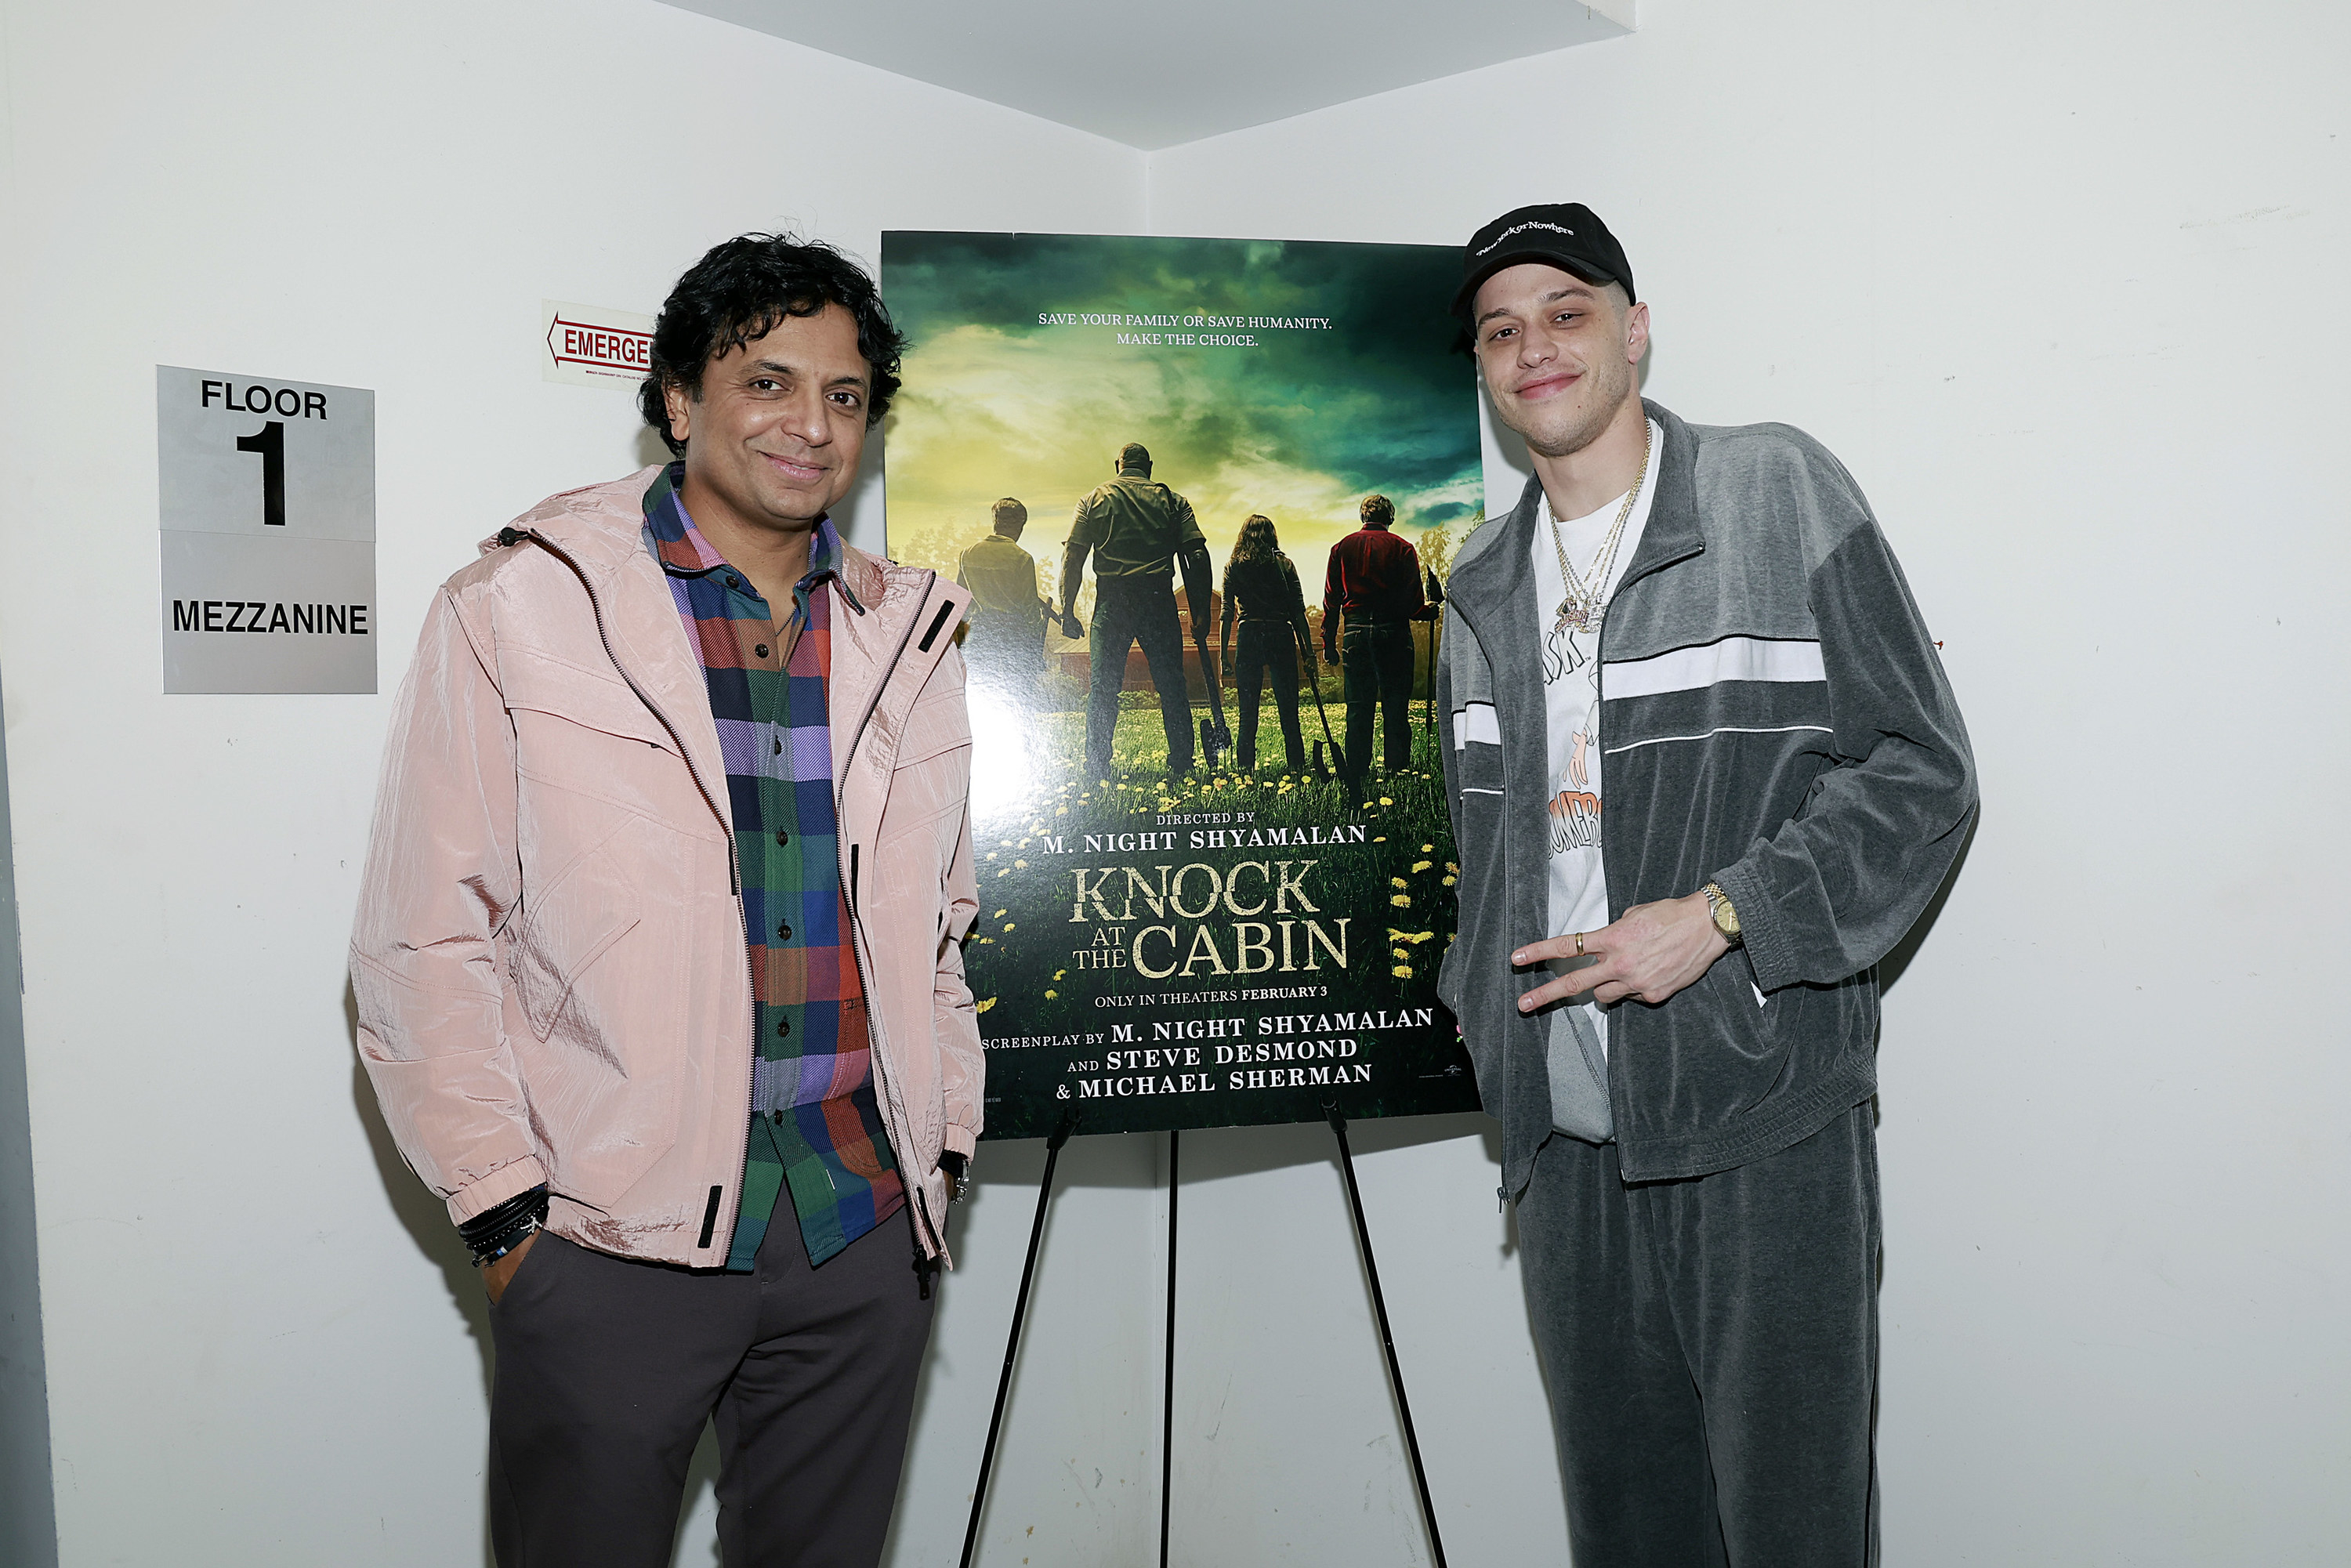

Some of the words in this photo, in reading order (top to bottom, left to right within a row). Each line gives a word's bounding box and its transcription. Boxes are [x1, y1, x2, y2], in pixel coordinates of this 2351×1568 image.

[1476, 241, 1498, 256] New
[1497, 226, 1516, 243] York
[1515, 223, 1528, 234] or
[1528, 221, 1574, 235] Nowhere
[1039, 313, 1076, 324] SAVE
[1081, 314, 1121, 325] YOUR
[1126, 315, 1179, 326] FAMILY
[1184, 316, 1204, 326] OR
[1208, 316, 1244, 327] SAVE
[1248, 317, 1331, 328] HUMANITY.
[566, 330, 654, 364] EMERGE
[1117, 334, 1161, 344] MAKE
[1165, 334, 1195, 345] THE
[1199, 335, 1258, 346] CHOICE.
[202, 380, 327, 419] FLOOR
[237, 421, 285, 526] 1
[173, 600, 368, 634] MEZZANINE
[1157, 813, 1231, 825] DIRECTED
[1236, 812, 1255, 824] BY
[1042, 836, 1073, 854] M.
[1083, 831, 1176, 853] NIGHT
[1190, 825, 1366, 849] SHYAMALAN
[1069, 859, 1320, 925] KNOCK
[1073, 949, 1126, 969] THE
[1132, 918, 1351, 979] CABIN
[1092, 927, 1125, 946] AT
[1096, 996, 1134, 1007] ONLY
[1139, 994, 1154, 1005] IN
[1160, 990, 1237, 1004] THEATERS
[1242, 987, 1317, 1000] FEBRUARY
[1321, 987, 1327, 996] 3
[980, 1035, 1080, 1052] SCREENPLAY
[1086, 1034, 1104, 1044] BY
[1111, 1024, 1142, 1042] M.
[1153, 1019, 1244, 1040] NIGHT
[1259, 1009, 1433, 1034] SHYAMALAN
[1067, 1061, 1099, 1072] AND
[1107, 1048, 1200, 1070] STEVE
[1215, 1039, 1357, 1063] DESMOND
[1056, 1085, 1070, 1099] &
[1079, 1074, 1215, 1098] MICHAEL
[1230, 1064, 1371, 1089] SHERMAN
